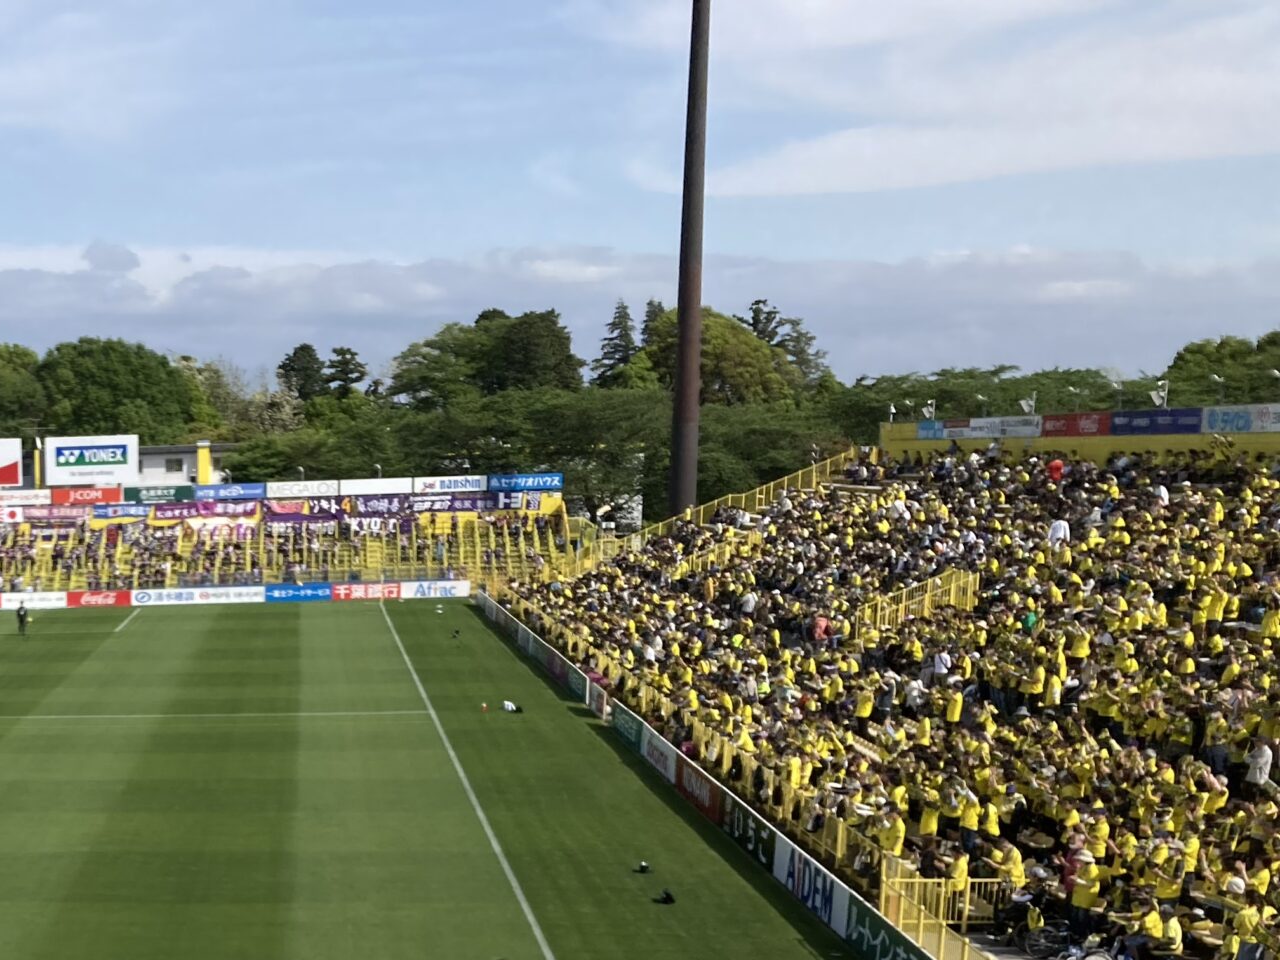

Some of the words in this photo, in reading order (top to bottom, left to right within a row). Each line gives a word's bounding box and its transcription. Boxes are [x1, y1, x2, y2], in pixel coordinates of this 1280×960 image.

[83, 448, 124, 463] YONEX
[269, 482, 337, 495] MEGALOS
[439, 477, 481, 490] nanshin
[500, 476, 561, 488] セナリオハウス
[334, 583, 400, 600] 千葉銀行
[414, 582, 457, 598] Aflac
